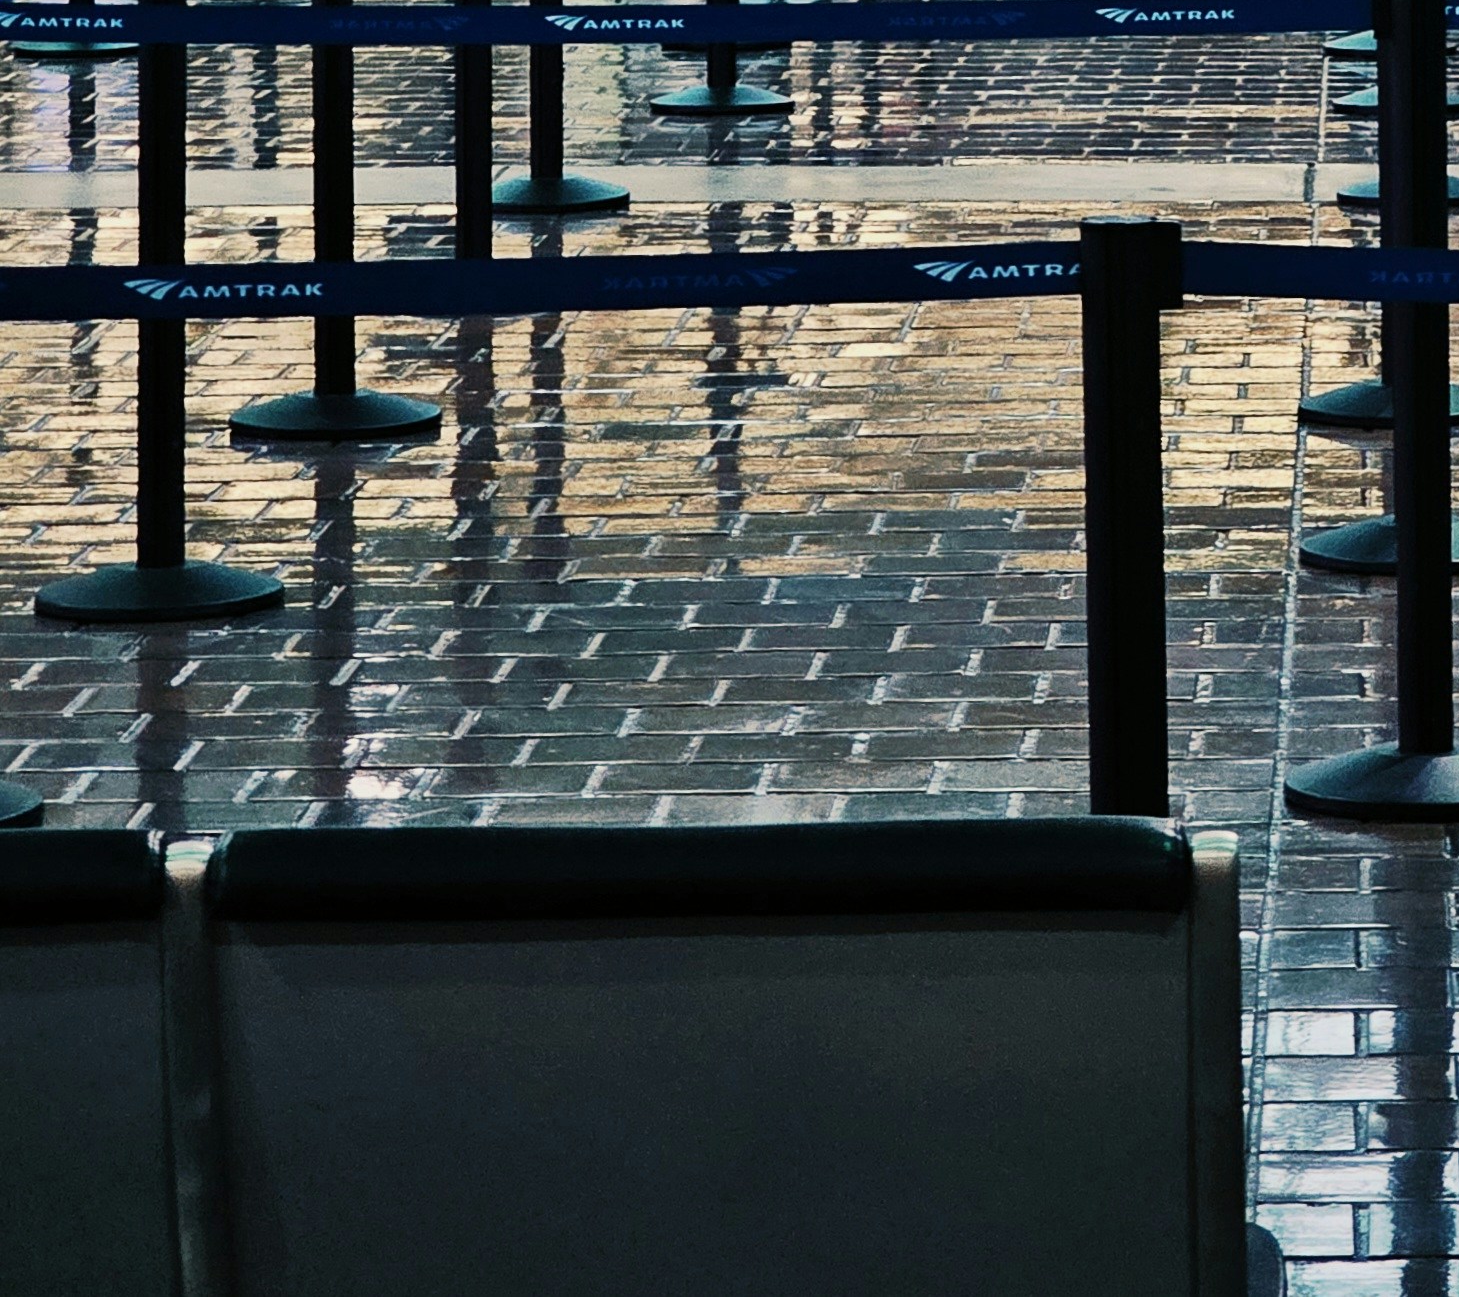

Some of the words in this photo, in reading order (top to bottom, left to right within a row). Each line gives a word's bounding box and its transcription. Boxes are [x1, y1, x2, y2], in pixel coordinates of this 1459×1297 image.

[1134, 8, 1236, 22] AMTRAK
[20, 16, 124, 29] AMTRAK
[583, 18, 685, 30] AMTRAK
[967, 261, 1082, 279] AMTRA
[178, 282, 324, 299] AMTRAK
